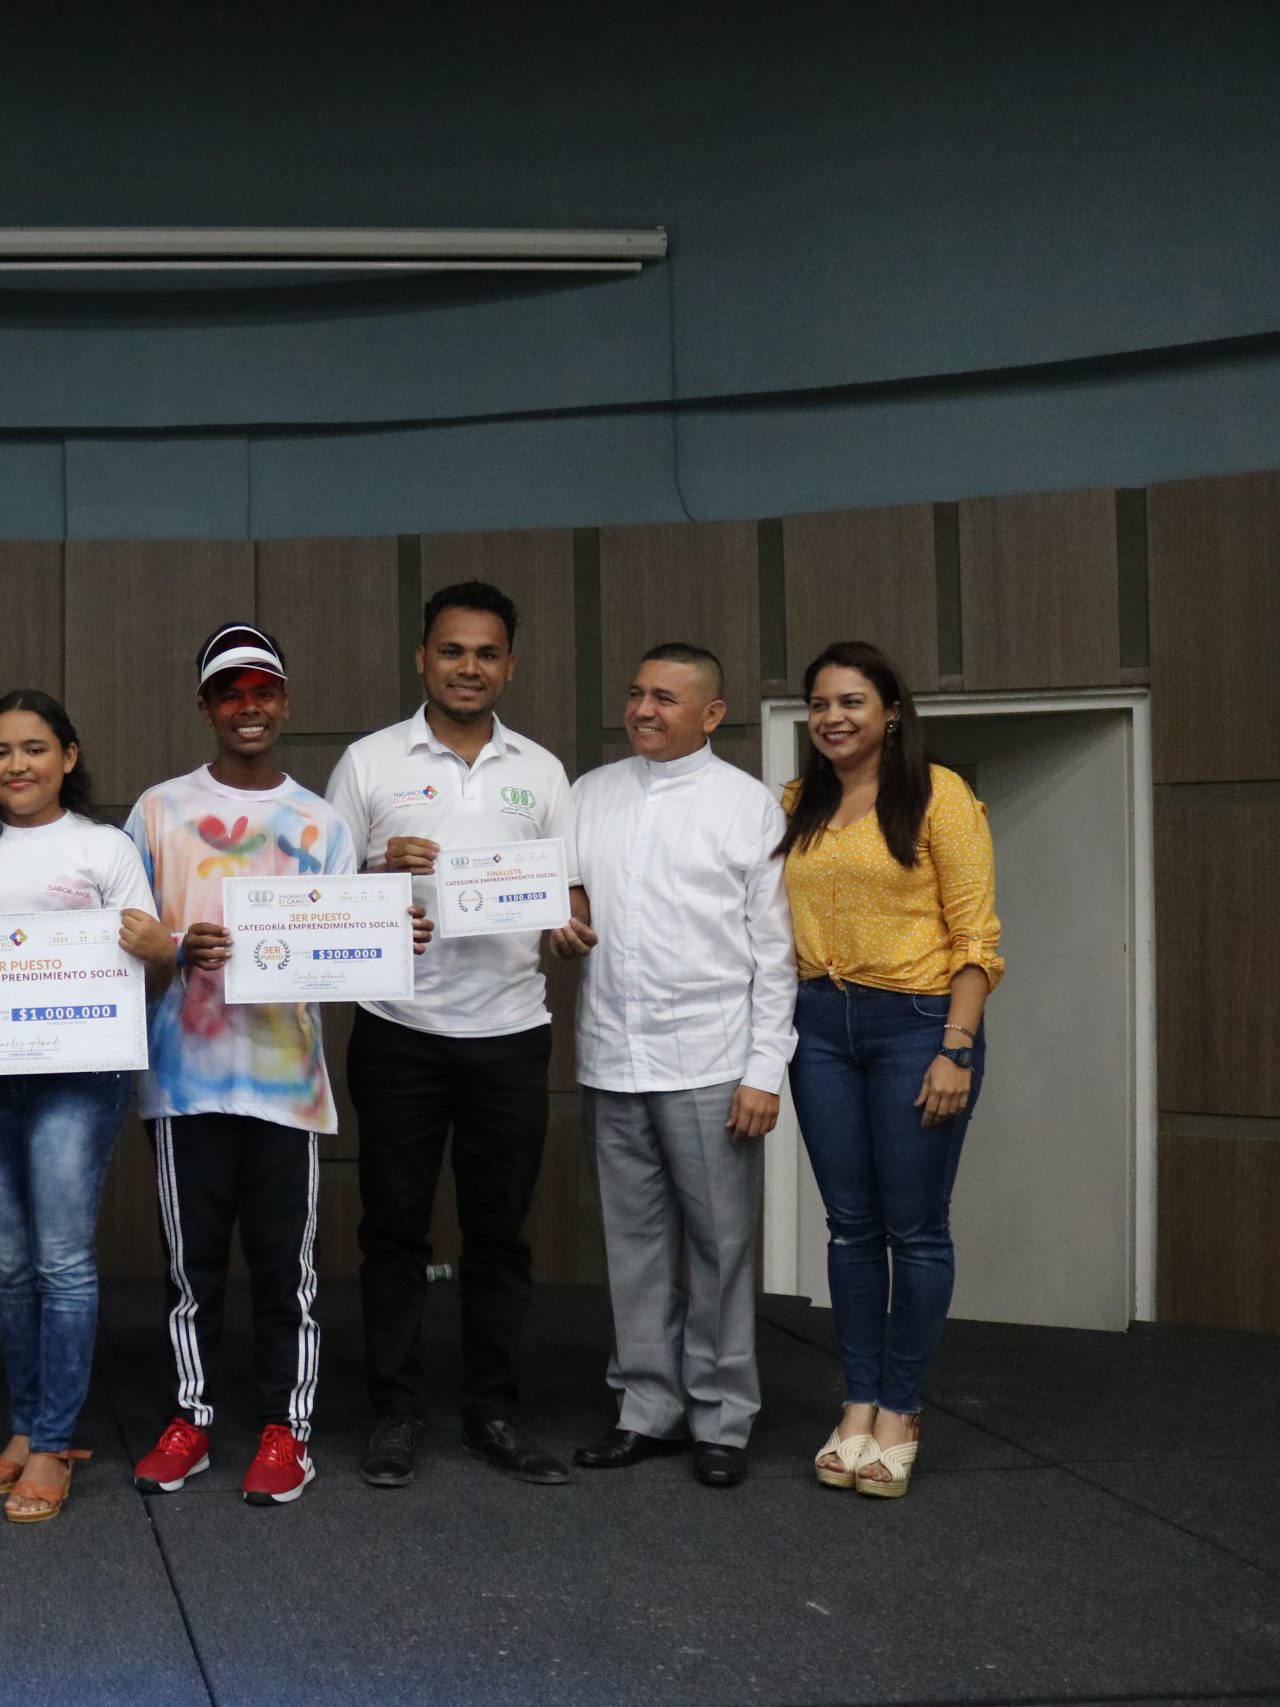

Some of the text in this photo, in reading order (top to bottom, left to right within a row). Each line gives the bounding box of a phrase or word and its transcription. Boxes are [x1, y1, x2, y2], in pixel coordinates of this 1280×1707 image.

[487, 869, 522, 877] FINALISTA
[480, 874, 535, 884] EMPRENDIMIENTO
[290, 913, 351, 922] 3ER PUESTO
[238, 921, 400, 931] CATEGORÍA EMPRENDIMIENTO SOCIAL
[263, 946, 281, 954] 3ER
[318, 949, 377, 960] $300.000
[11, 959, 62, 971] PUESTO
[90, 968, 129, 979] SOCIAL
[19, 1005, 111, 1022] $1.000.000
